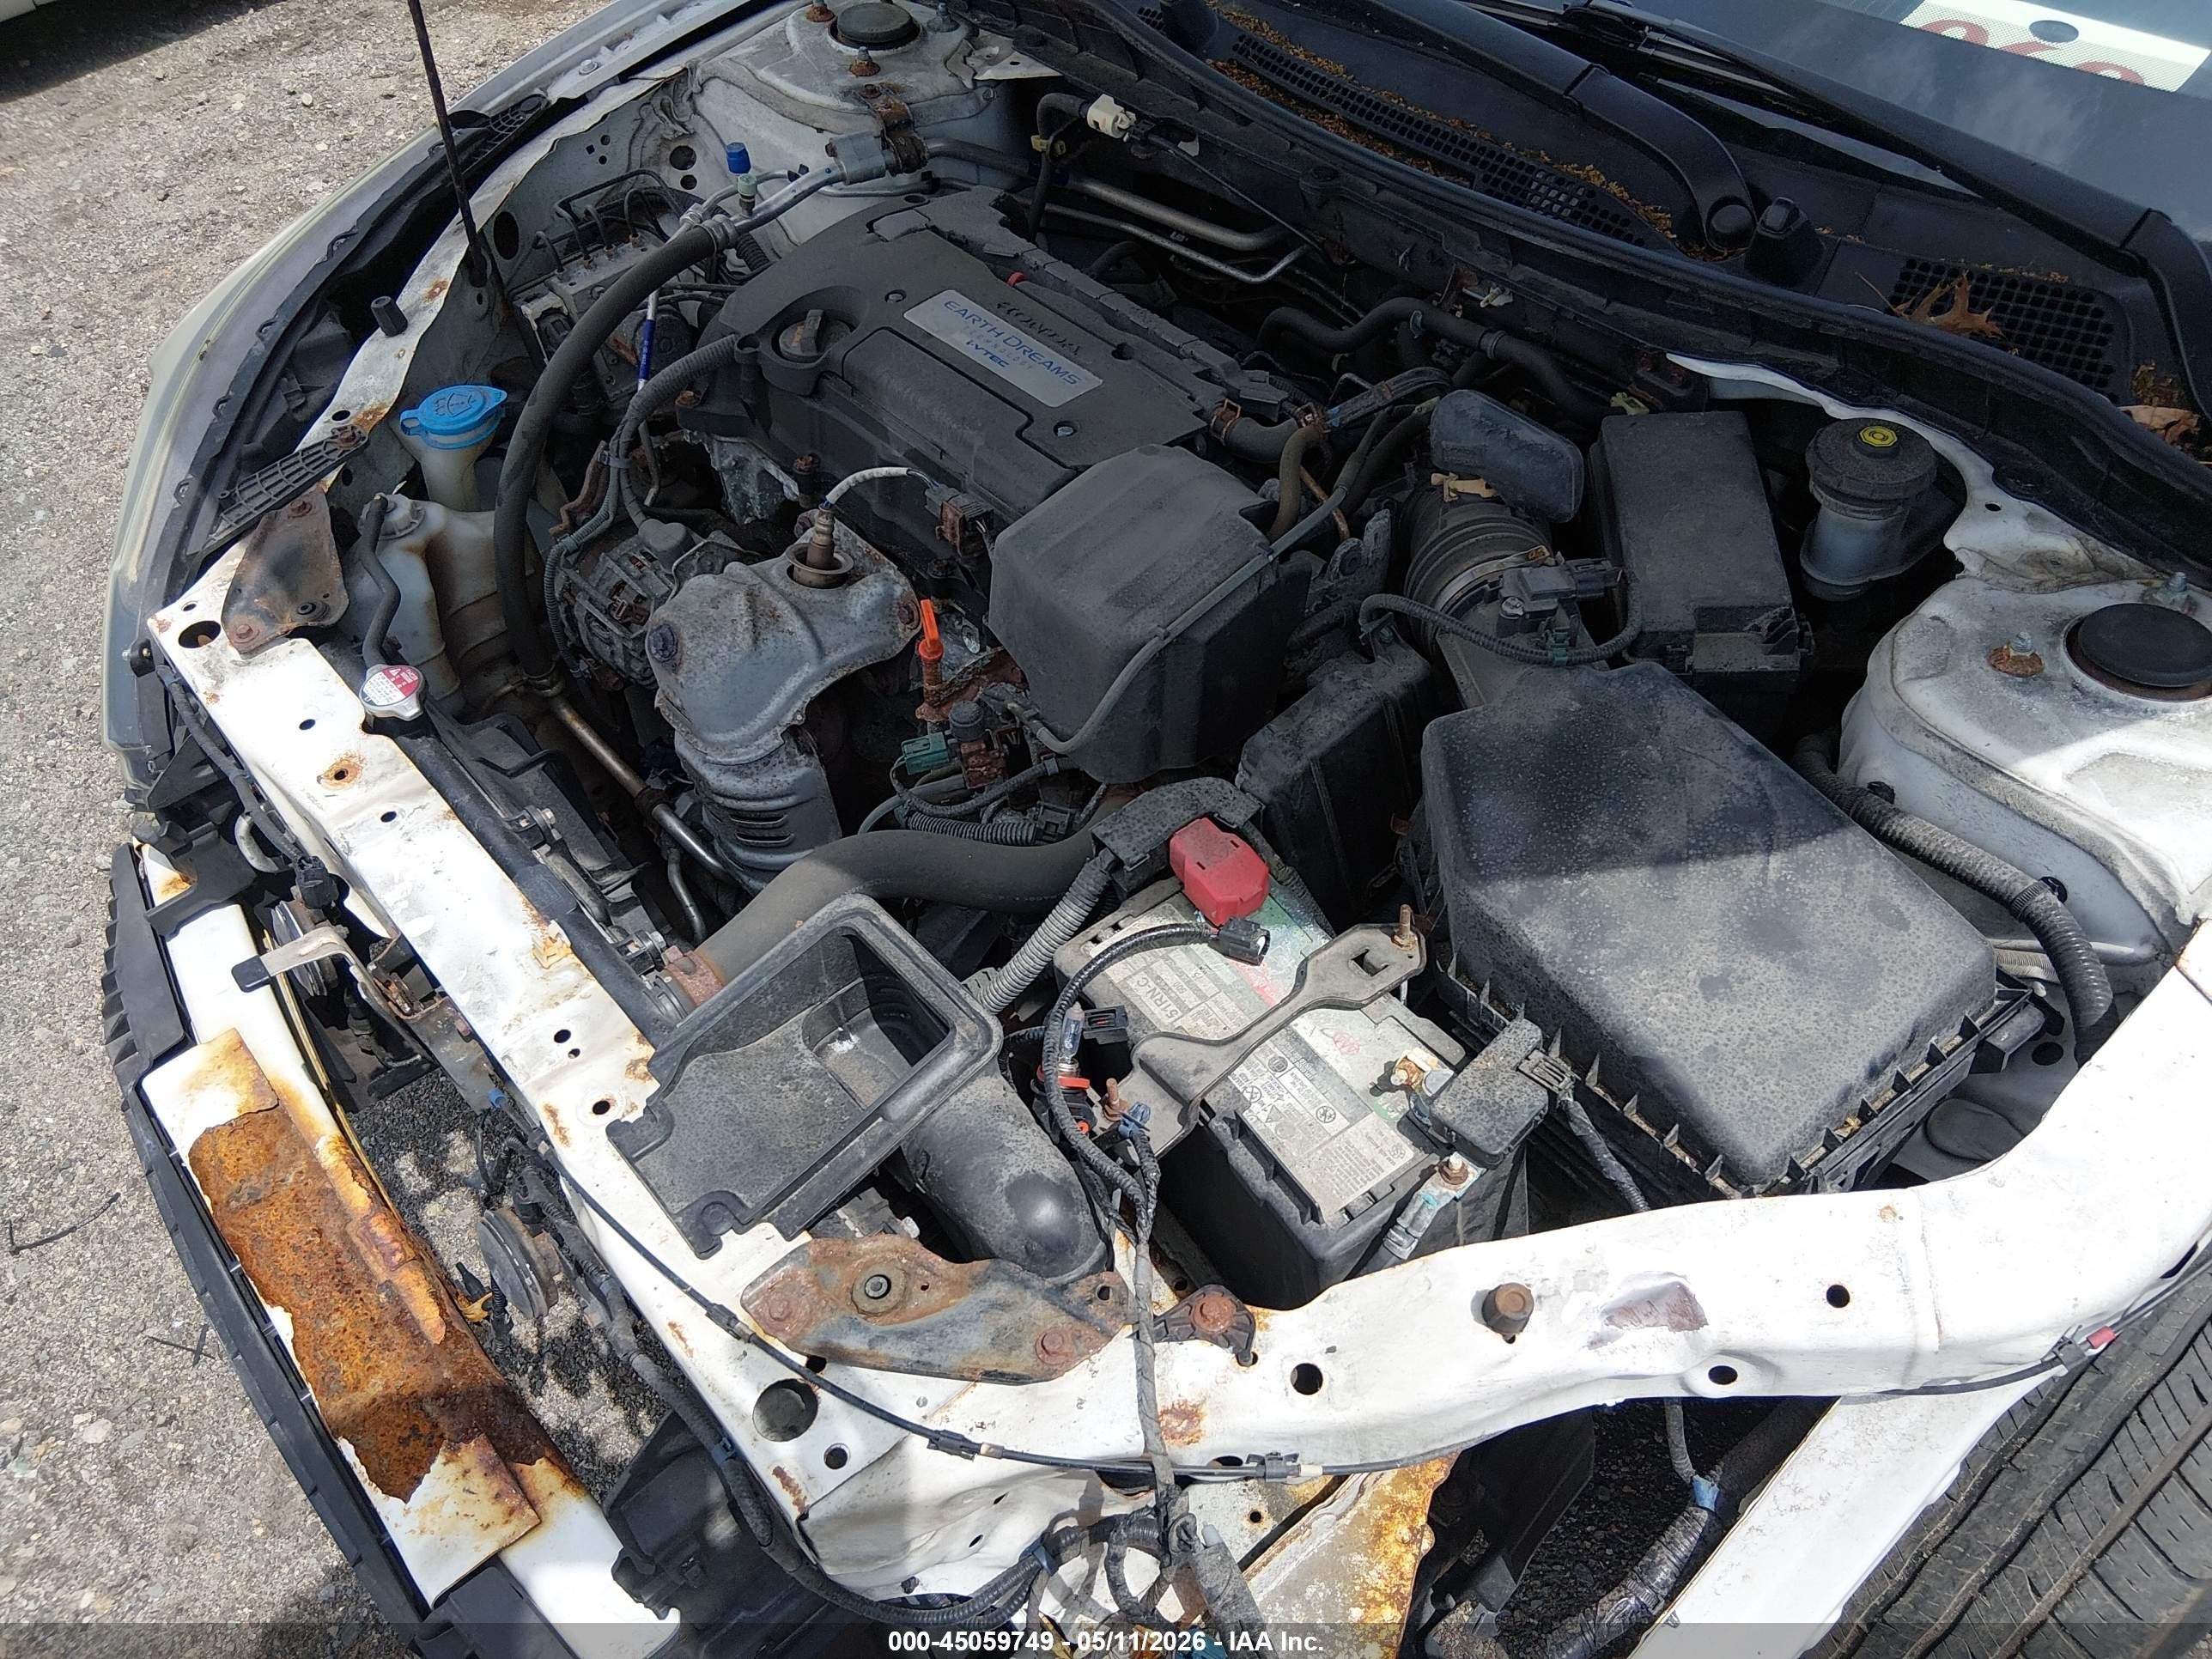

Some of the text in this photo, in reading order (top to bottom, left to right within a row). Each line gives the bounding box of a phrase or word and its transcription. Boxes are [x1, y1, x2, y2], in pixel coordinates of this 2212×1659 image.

[944, 300, 1083, 385] EARTH DREAMS
[1134, 975, 1180, 1019] 51RN-C
